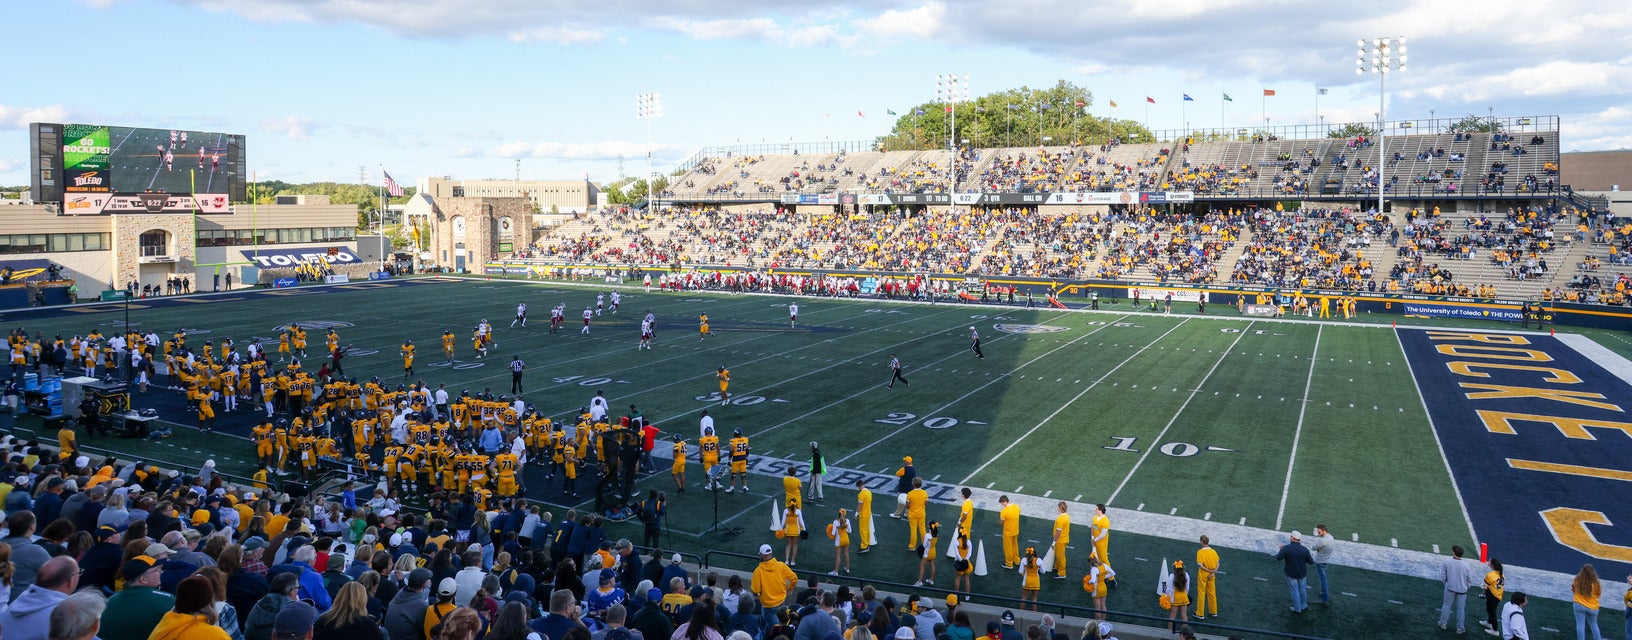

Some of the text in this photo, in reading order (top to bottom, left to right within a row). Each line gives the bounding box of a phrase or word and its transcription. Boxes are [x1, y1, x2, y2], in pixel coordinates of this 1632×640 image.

[63, 146, 110, 154] ROCKETS!
[74, 177, 103, 186] TOLEDO
[252, 252, 353, 266] TOLEDO
[1420, 308, 1451, 316] University
[553, 375, 612, 386] 40
[484, 407, 494, 415] 32
[874, 412, 958, 430] 20
[540, 425, 549, 433] 21
[416, 431, 428, 440] 88
[300, 443, 311, 451] 32
[704, 443, 715, 452] 62
[737, 443, 747, 453] 56
[1104, 436, 1199, 458] 10
[385, 449, 397, 457] 34
[472, 462, 483, 471] 55
[502, 461, 512, 470] 71
[555, 529, 563, 543] 1
